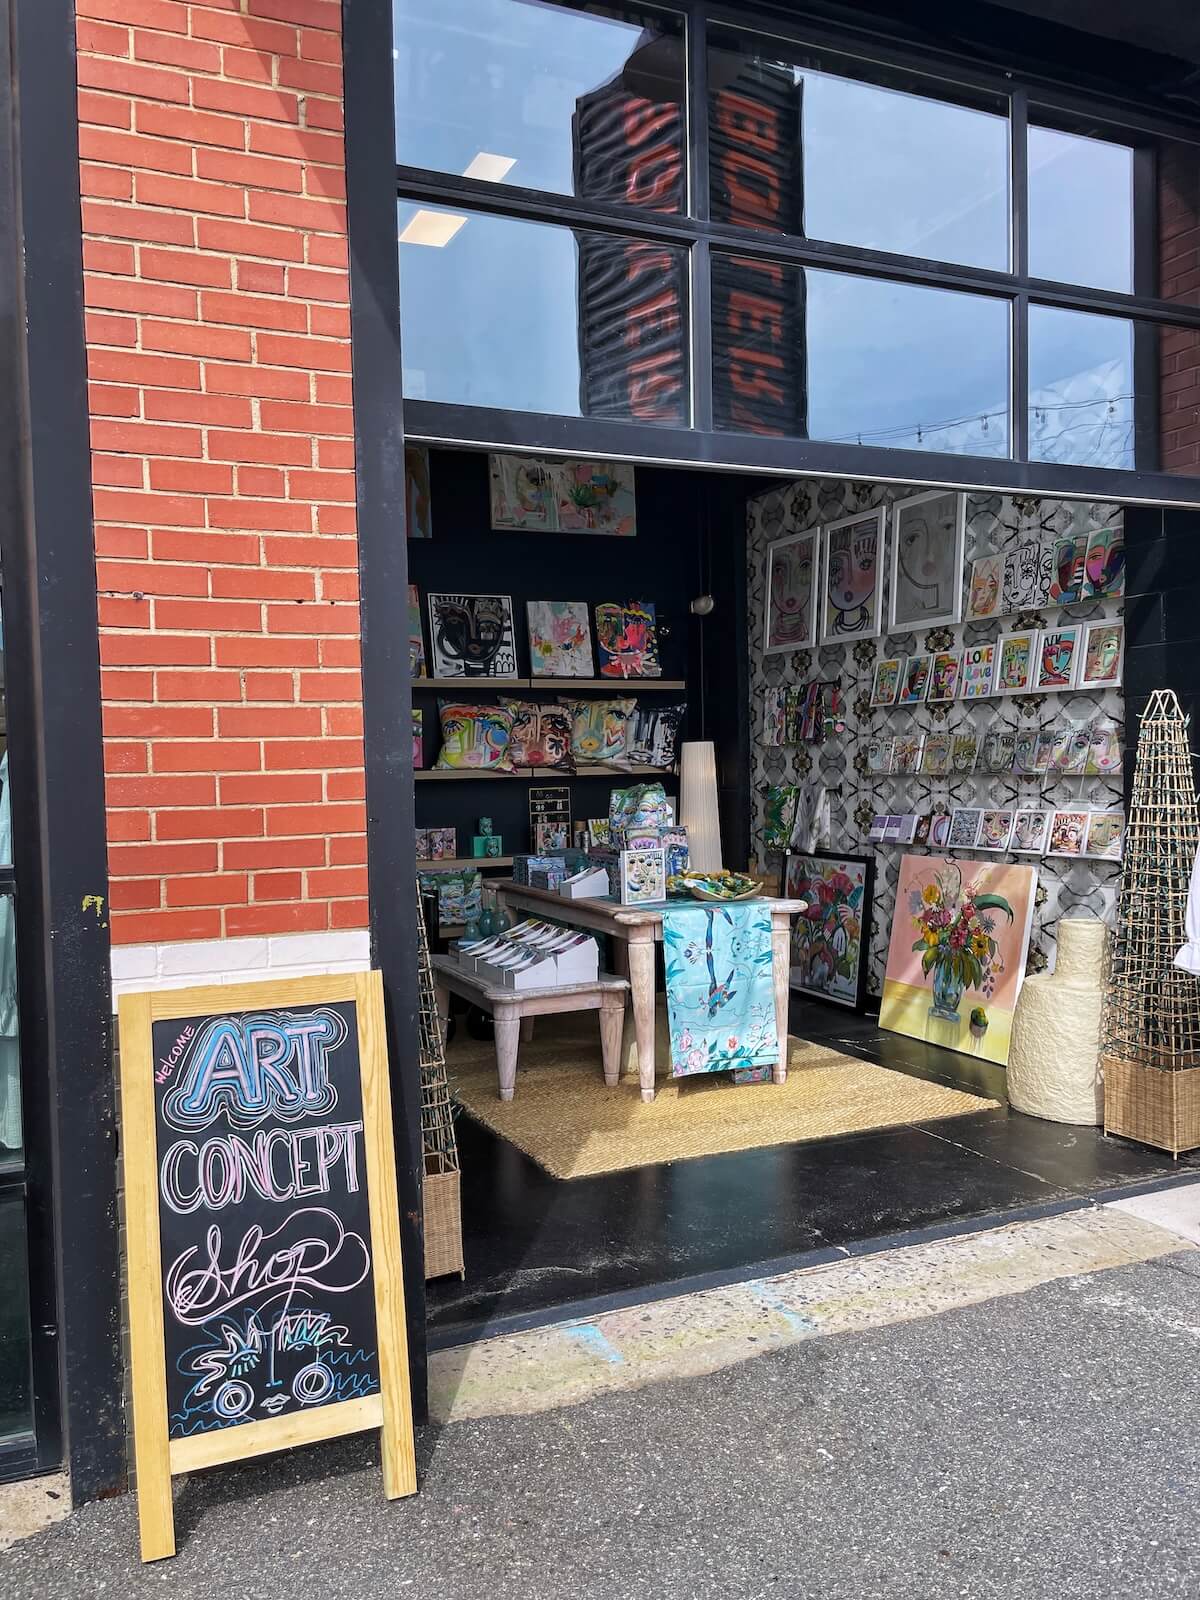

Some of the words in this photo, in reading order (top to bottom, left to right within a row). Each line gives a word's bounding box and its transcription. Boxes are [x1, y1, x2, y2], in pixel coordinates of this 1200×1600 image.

[966, 647, 994, 666] LOVE
[172, 1013, 340, 1120] ART
[161, 1120, 364, 1214] CONCEPT
[166, 1207, 371, 1328] Shop
